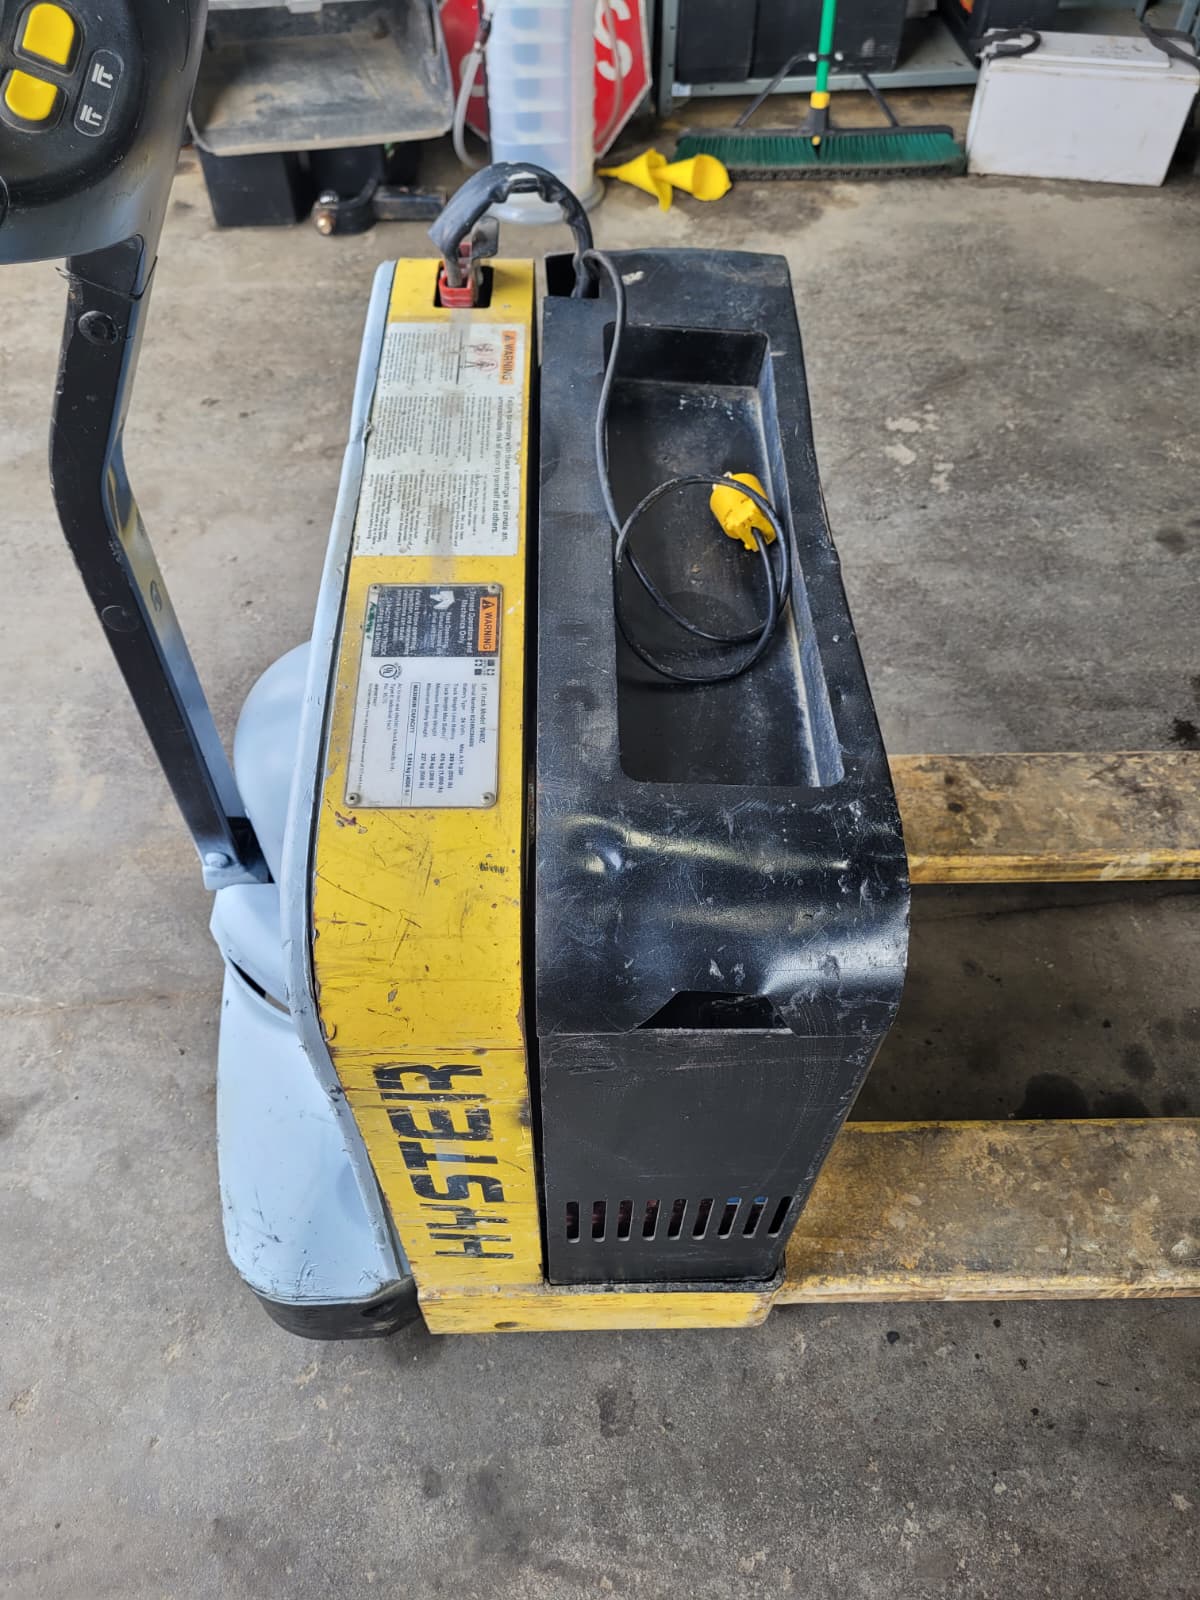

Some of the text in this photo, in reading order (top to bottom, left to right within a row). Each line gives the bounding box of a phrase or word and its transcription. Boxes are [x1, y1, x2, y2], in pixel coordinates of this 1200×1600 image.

[502, 344, 514, 381] WARNING
[504, 442, 512, 453] with
[492, 474, 501, 498] yourself
[502, 471, 510, 498] warnings
[492, 500, 500, 511] and
[502, 511, 510, 529] create
[468, 590, 476, 611] Trained
[382, 623, 390, 636] WITH
[458, 600, 468, 644] Mechanics Only
[467, 612, 476, 641] Operators
[483, 612, 494, 650] WARNING
[380, 637, 388, 656] TRUCK
[409, 709, 417, 733] CAPACITY
[373, 1064, 513, 1260] HYSTER
